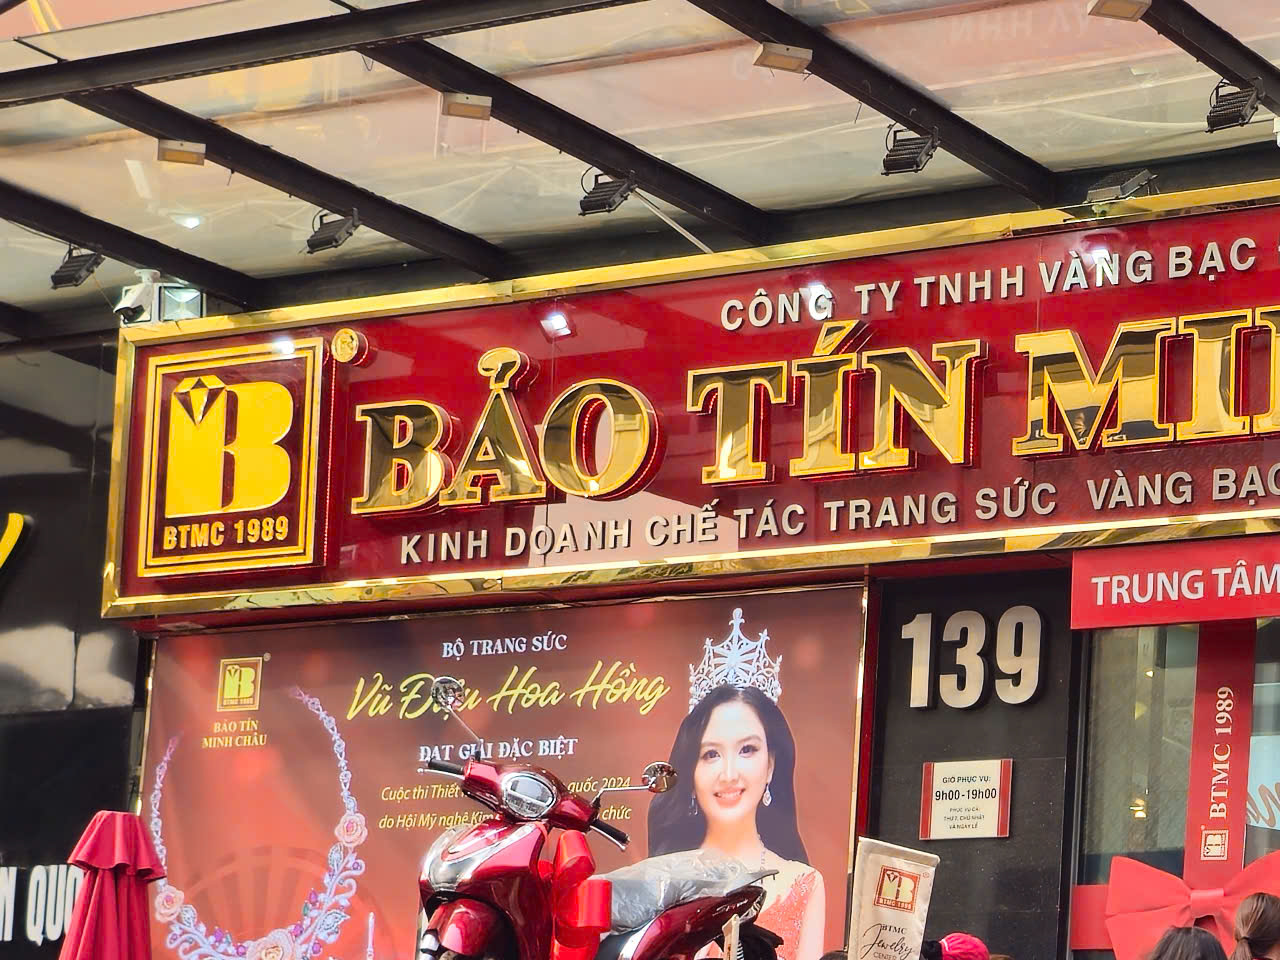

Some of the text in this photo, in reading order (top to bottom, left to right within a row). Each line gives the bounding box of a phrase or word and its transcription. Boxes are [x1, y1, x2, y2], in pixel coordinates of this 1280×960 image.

[720, 282, 833, 331] CÔNG
[855, 279, 900, 314] TY
[914, 267, 1025, 308] TNHH
[1039, 250, 1153, 293] VÀNG
[1167, 237, 1257, 283] BẠC
[351, 346, 658, 515] BẢO
[687, 319, 985, 485] TÍN
[163, 516, 289, 551] BTMC 1989
[401, 531, 488, 565] KINH
[505, 518, 631, 558] DOANH
[645, 498, 719, 547] CHẾ
[735, 500, 807, 541] TÁC
[829, 490, 957, 533] TRANG
[975, 476, 1058, 519] SỨC
[1087, 470, 1194, 511] VÀNG
[1092, 570, 1205, 606] TRUNG
[442, 630, 568, 661] BỘ TRANG SỨC
[901, 605, 1043, 711] 139
[486, 665, 567, 716] Hoa
[570, 660, 672, 717] Hồng
[1215, 685, 1235, 737] 1989
[498, 739, 534, 762] ĐẶC
[538, 735, 578, 760] BIỆT
[381, 786, 411, 802] Cuộc
[412, 785, 430, 800] thi
[431, 782, 461, 799] Thiết
[602, 776, 631, 790] 2024
[1210, 743, 1232, 820] BTMC
[378, 815, 394, 829] do
[396, 813, 417, 831] Hội
[418, 812, 437, 829] Mỹ
[602, 805, 632, 820] chức
